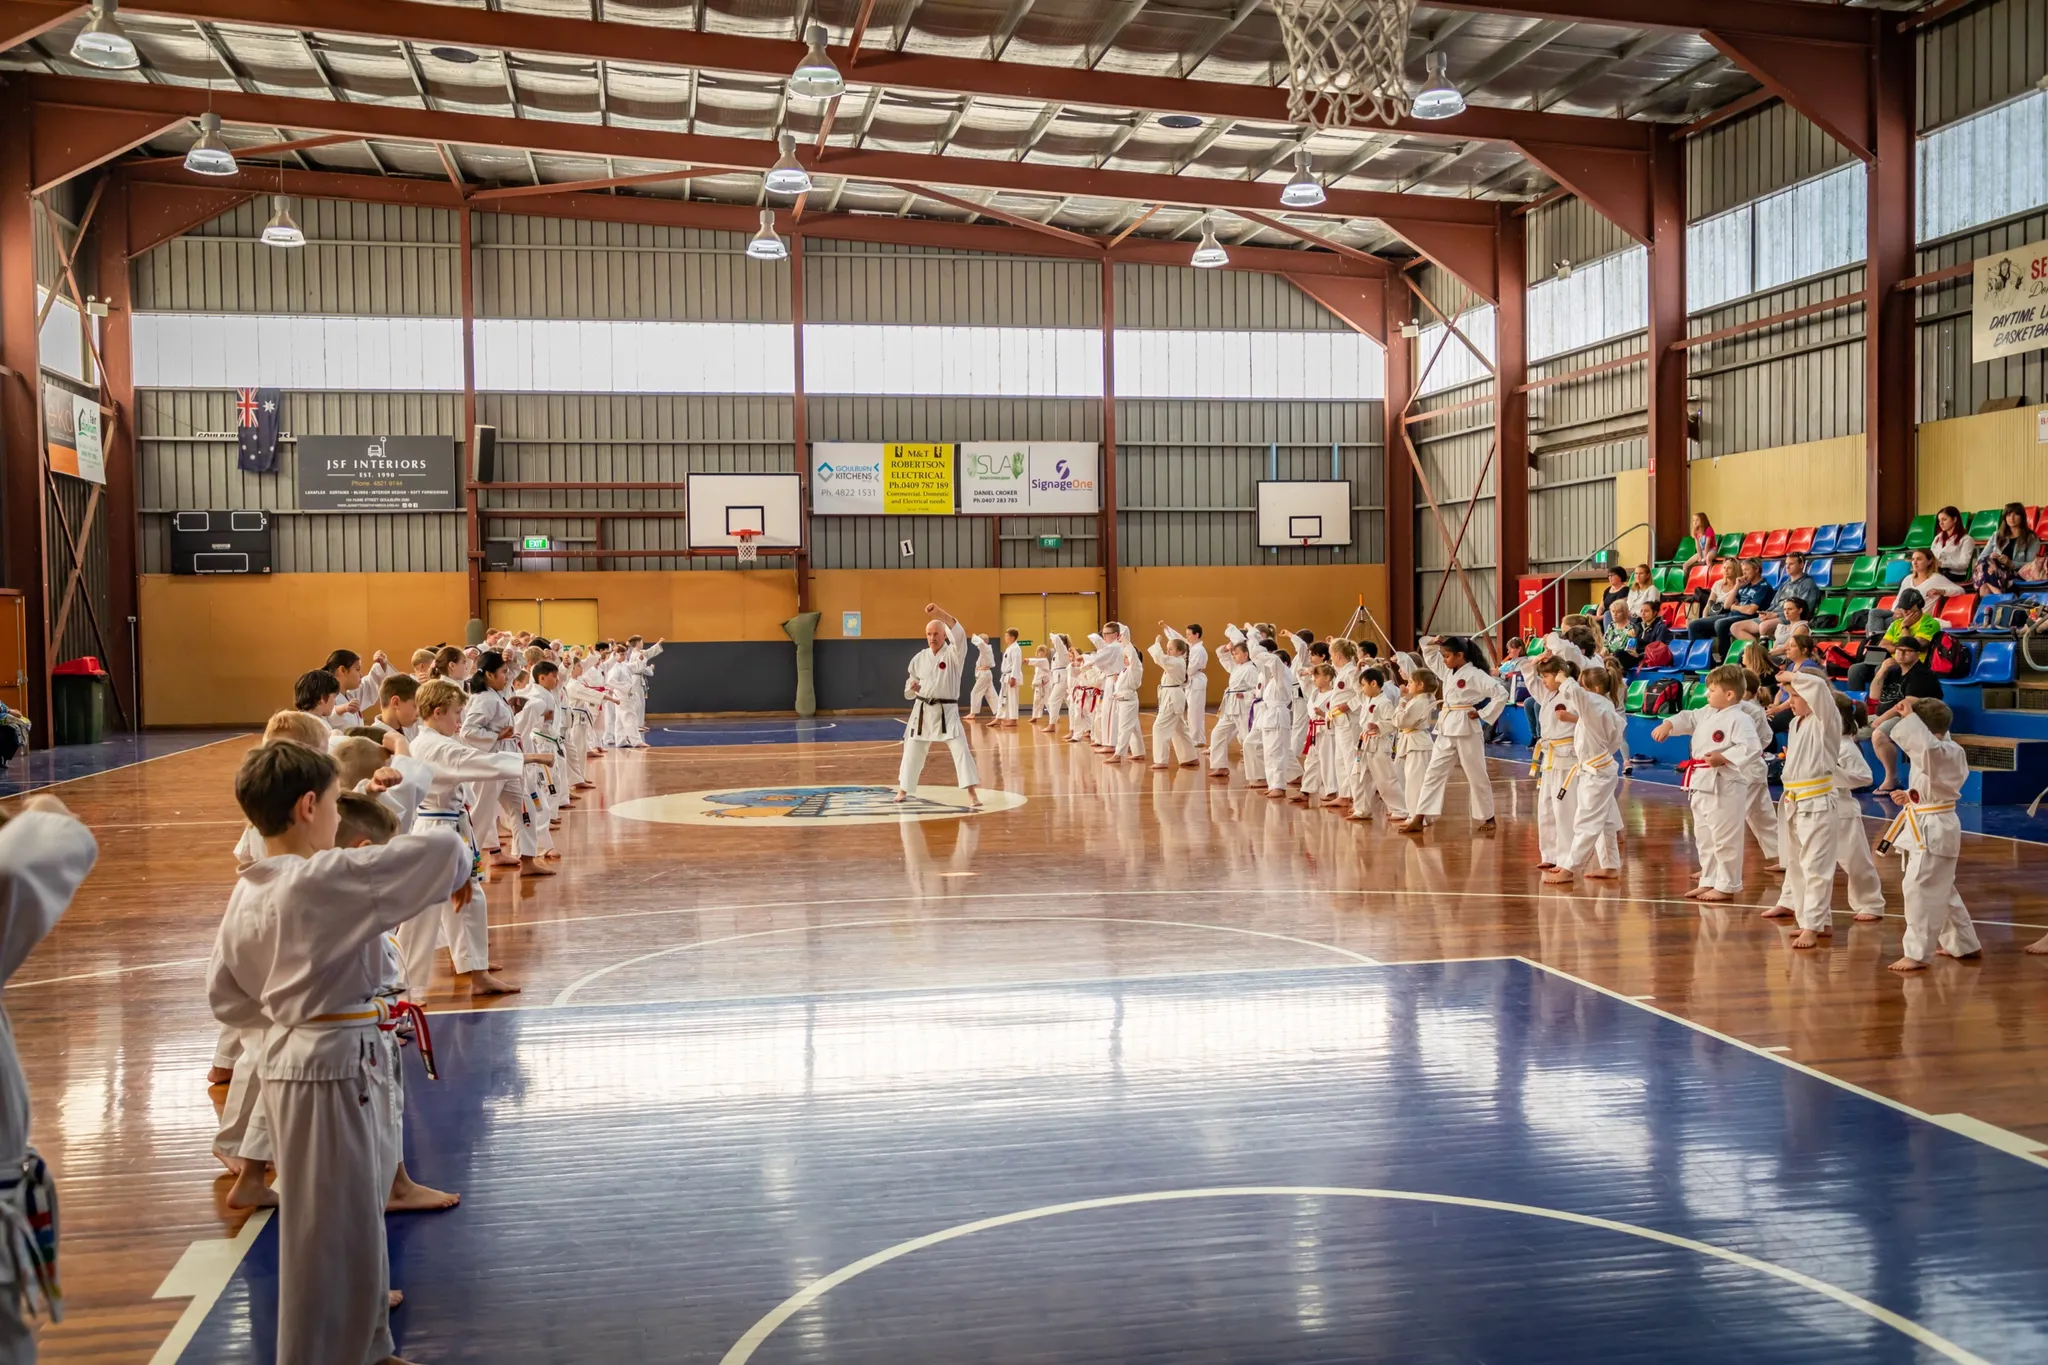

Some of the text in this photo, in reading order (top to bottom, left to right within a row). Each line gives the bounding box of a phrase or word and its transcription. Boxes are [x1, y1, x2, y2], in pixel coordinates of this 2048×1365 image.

[1989, 307, 2036, 331] DAYTIME
[907, 450, 929, 458] M&T
[326, 459, 427, 470] JSF INTERIORS
[835, 472, 873, 480] KITCHENS
[1031, 479, 1093, 491] SignageOne
[821, 489, 834, 497] Ph.
[528, 539, 542, 549] EXIT
[1044, 538, 1057, 546] EXIT
[904, 541, 911, 554] 1
